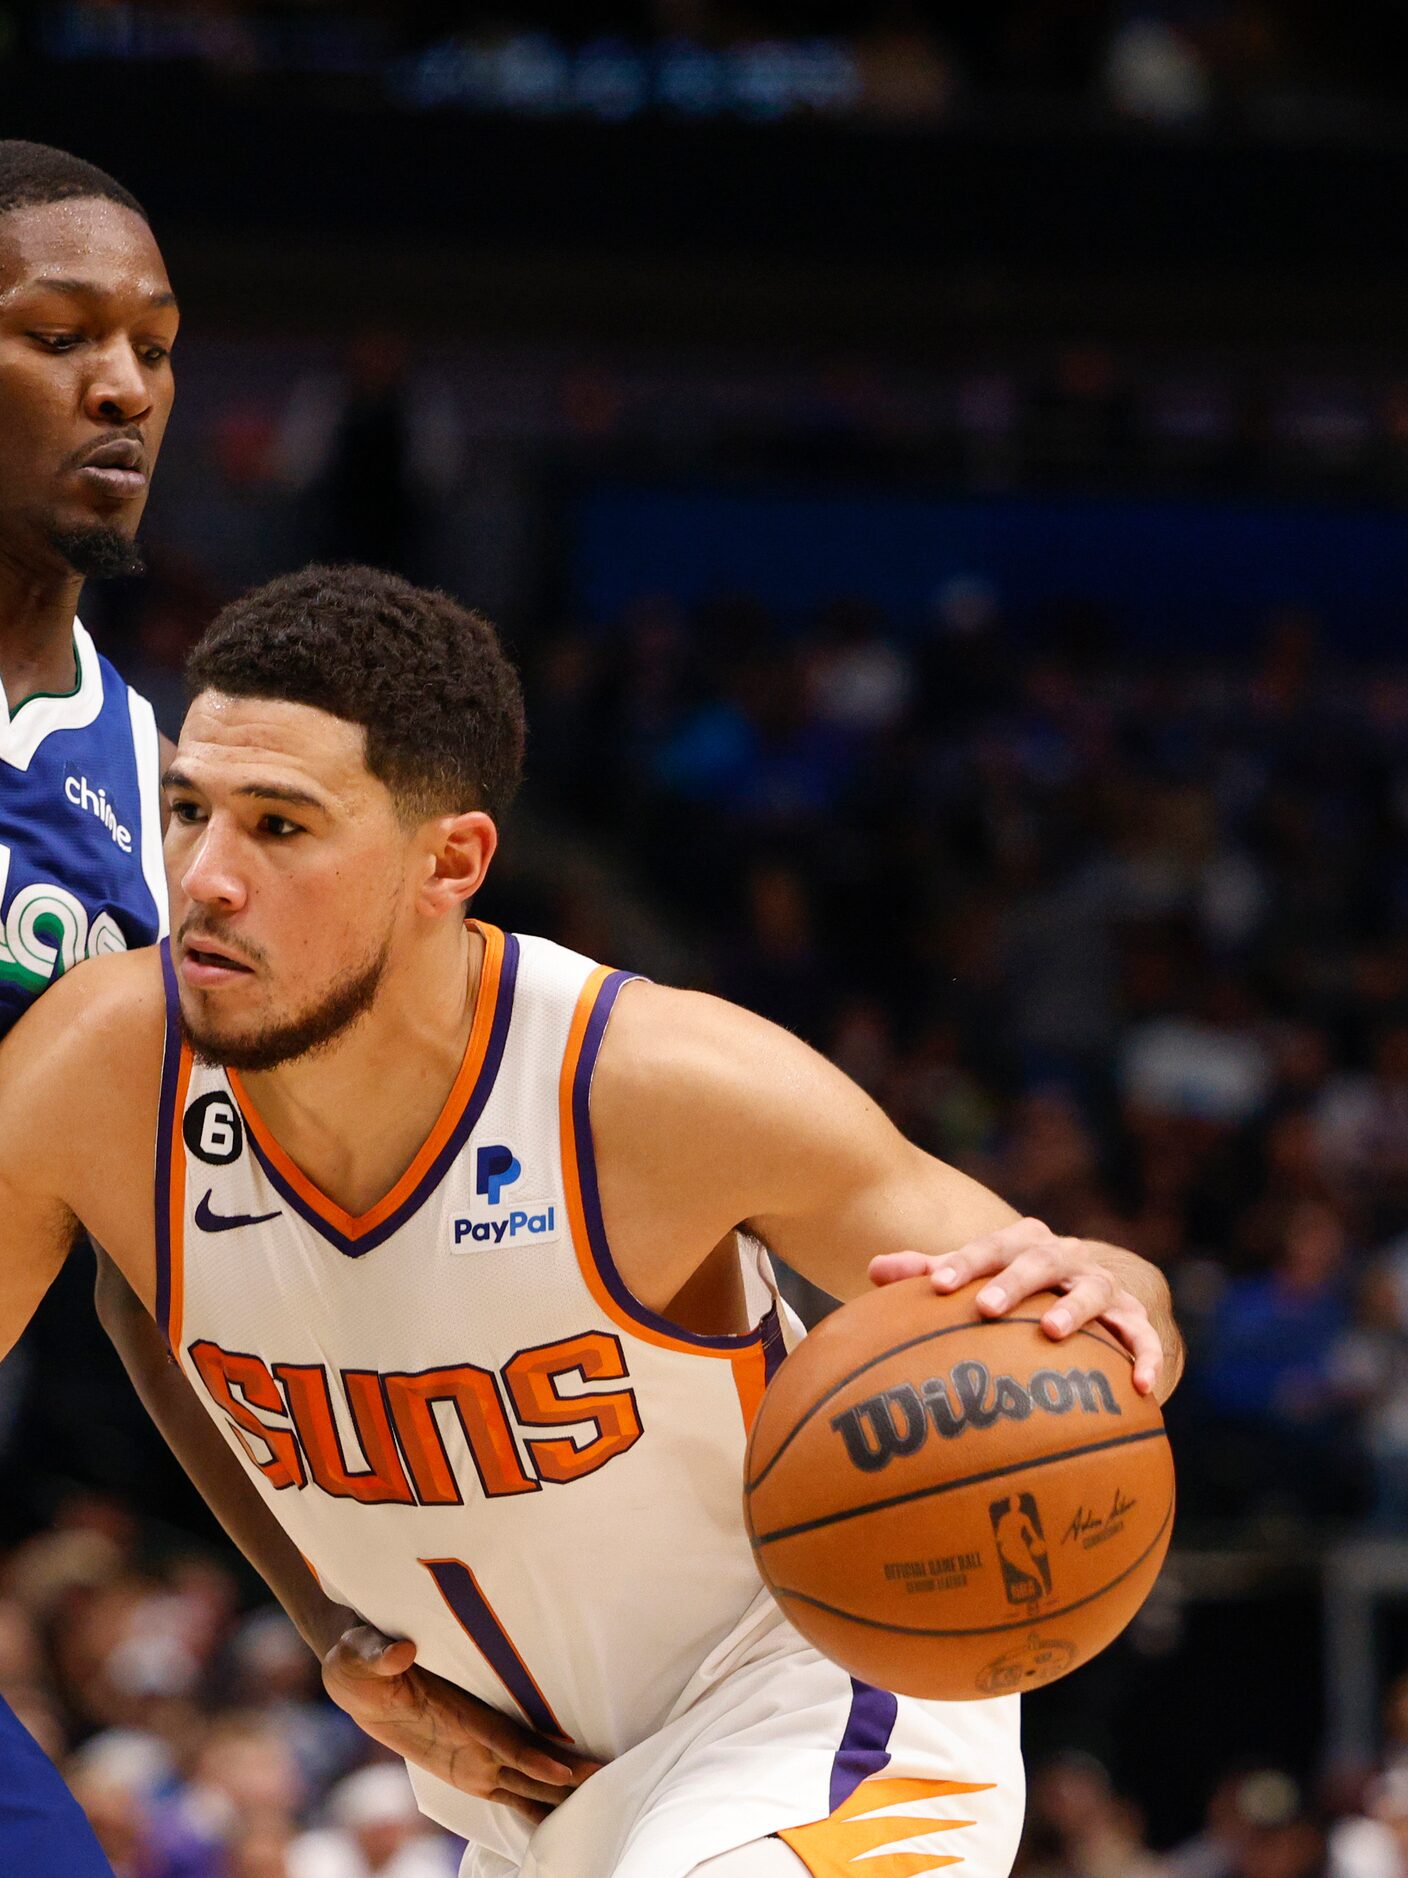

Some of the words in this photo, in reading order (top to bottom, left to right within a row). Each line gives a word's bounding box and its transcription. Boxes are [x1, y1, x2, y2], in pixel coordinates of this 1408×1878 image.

[64, 775, 132, 853] chime
[199, 1102, 234, 1157] 6
[454, 1206, 555, 1245] PayPal
[830, 1359, 1122, 1473] Wilson
[417, 1557, 575, 1744] 1
